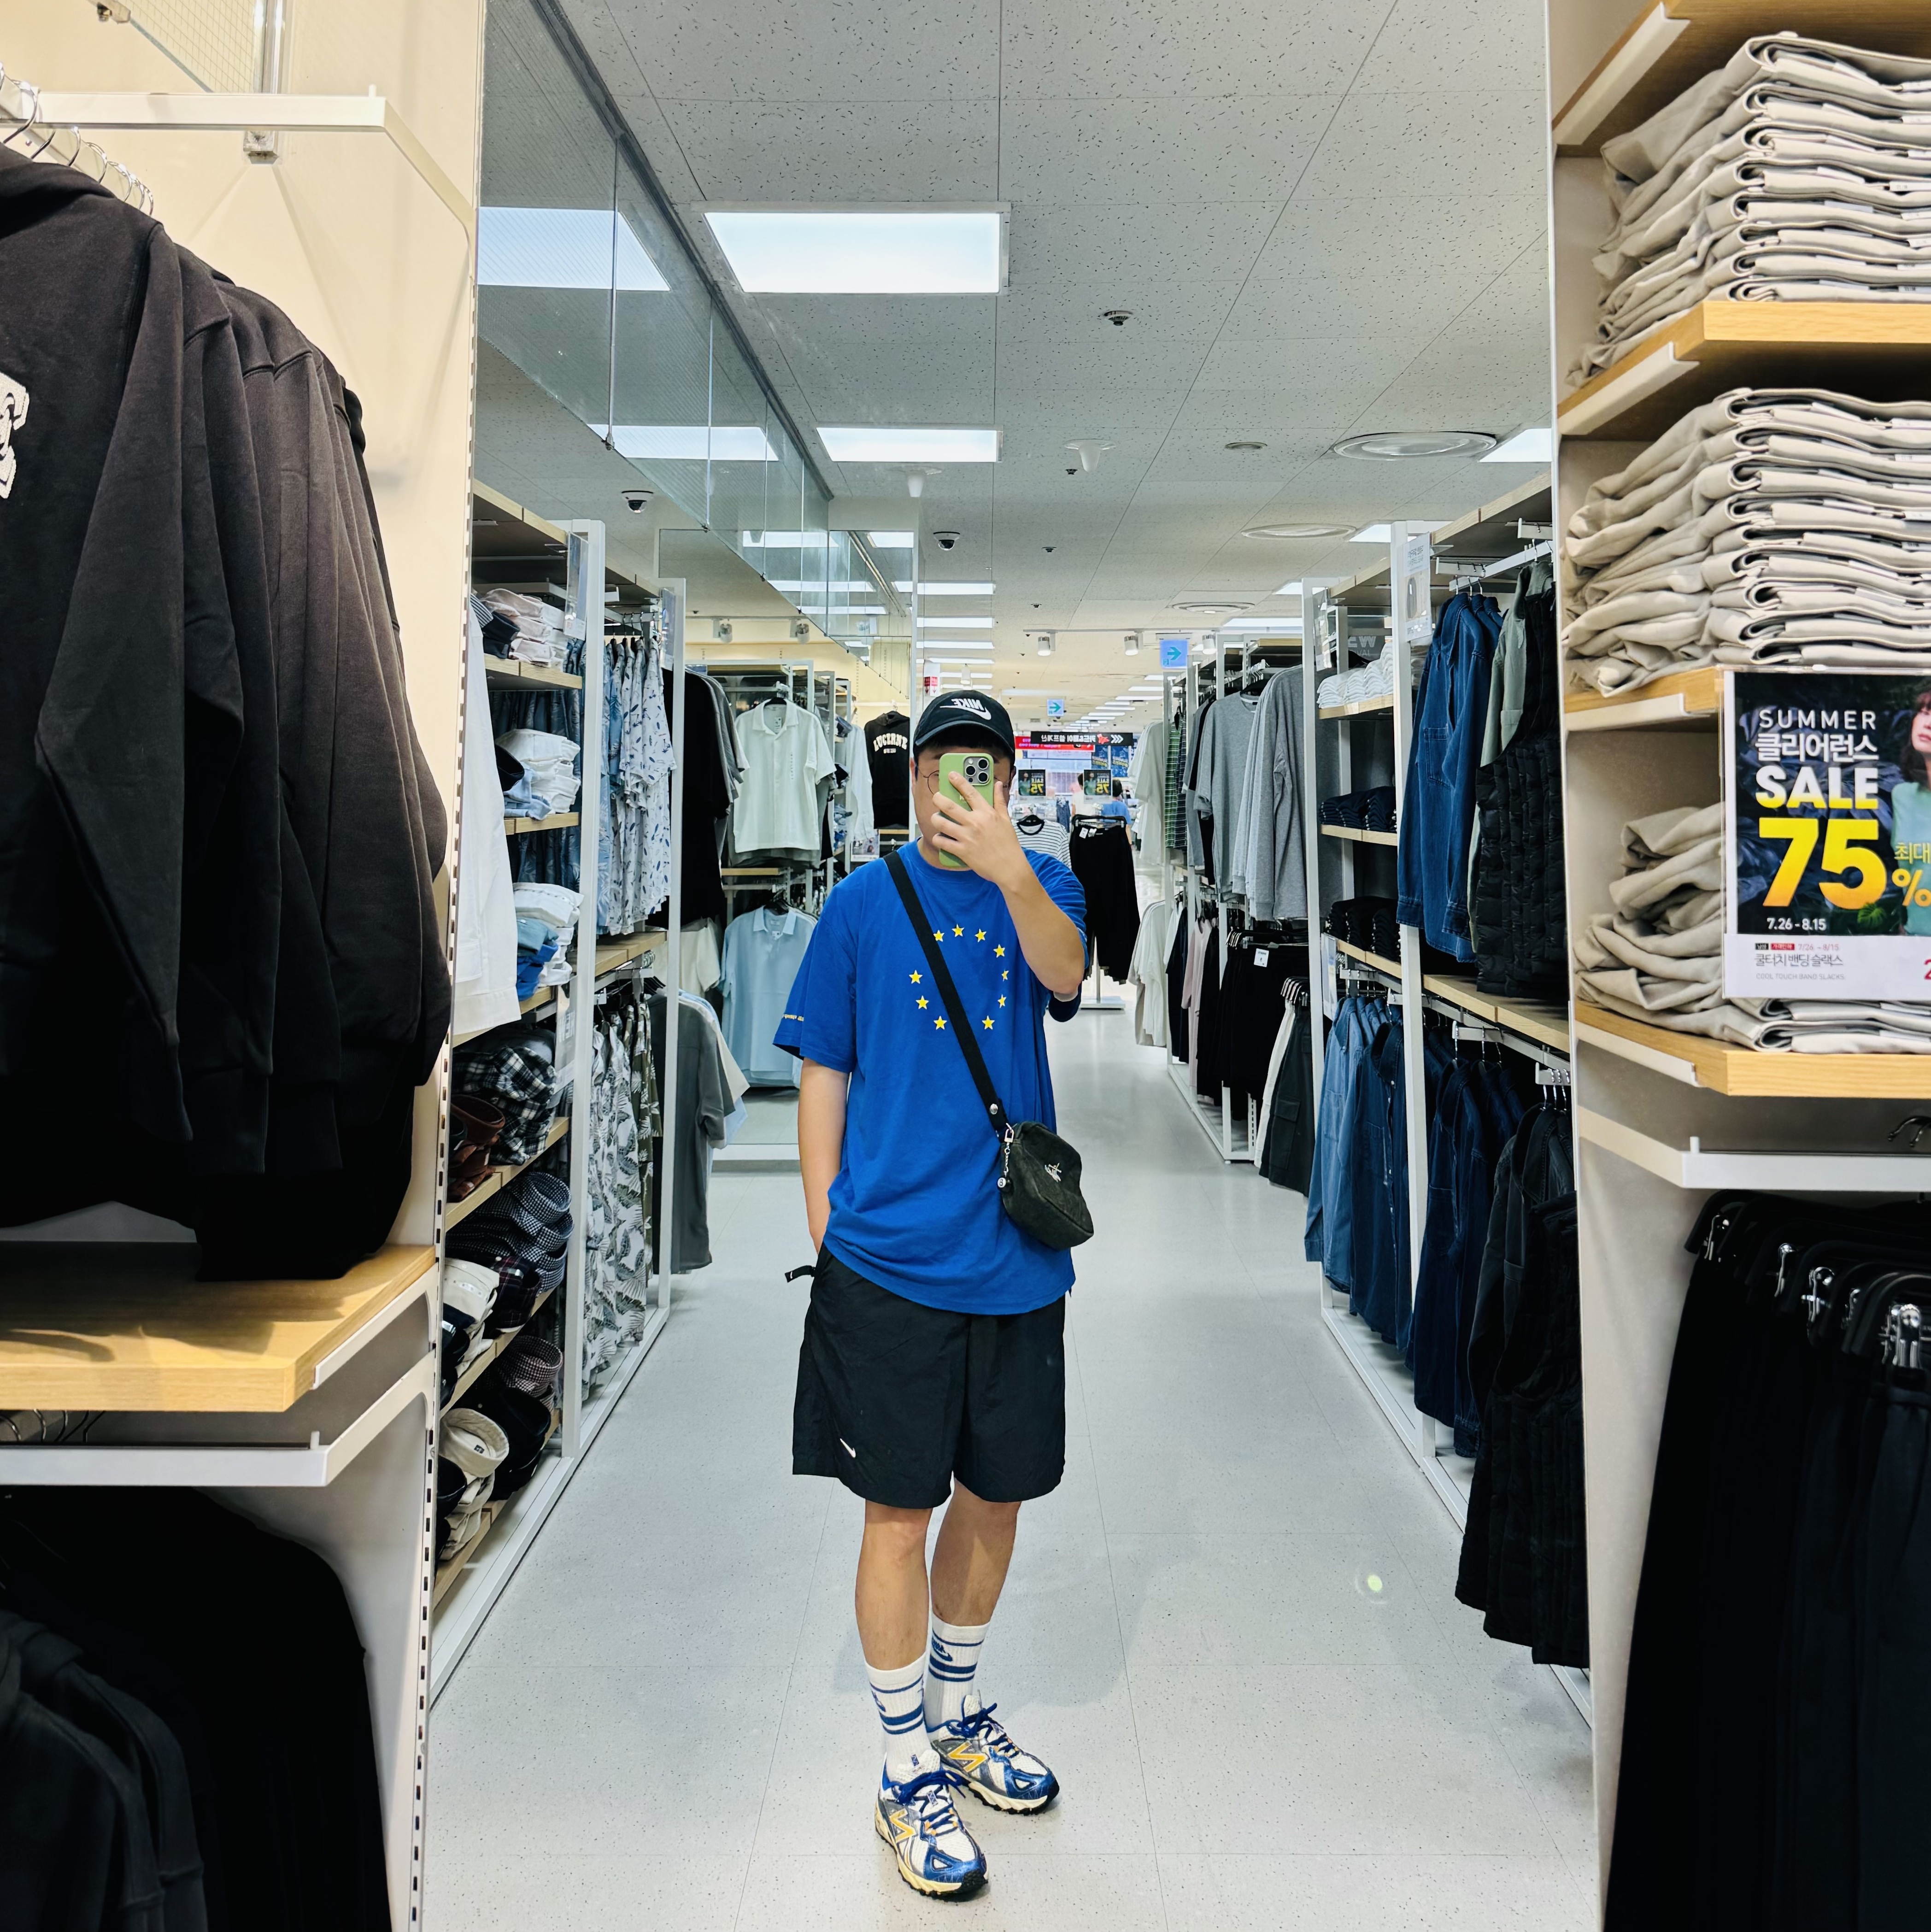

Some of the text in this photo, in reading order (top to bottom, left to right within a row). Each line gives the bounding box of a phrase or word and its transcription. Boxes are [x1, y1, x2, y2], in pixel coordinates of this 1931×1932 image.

[1759, 709, 1876, 730] SUMMER
[1755, 733, 1879, 763] 클리어런스
[1755, 765, 1879, 810] SALE
[1894, 842, 1931, 864] 최대
[1755, 953, 1787, 967] 쿨터치
[1810, 954, 1843, 967] 슬랙스
